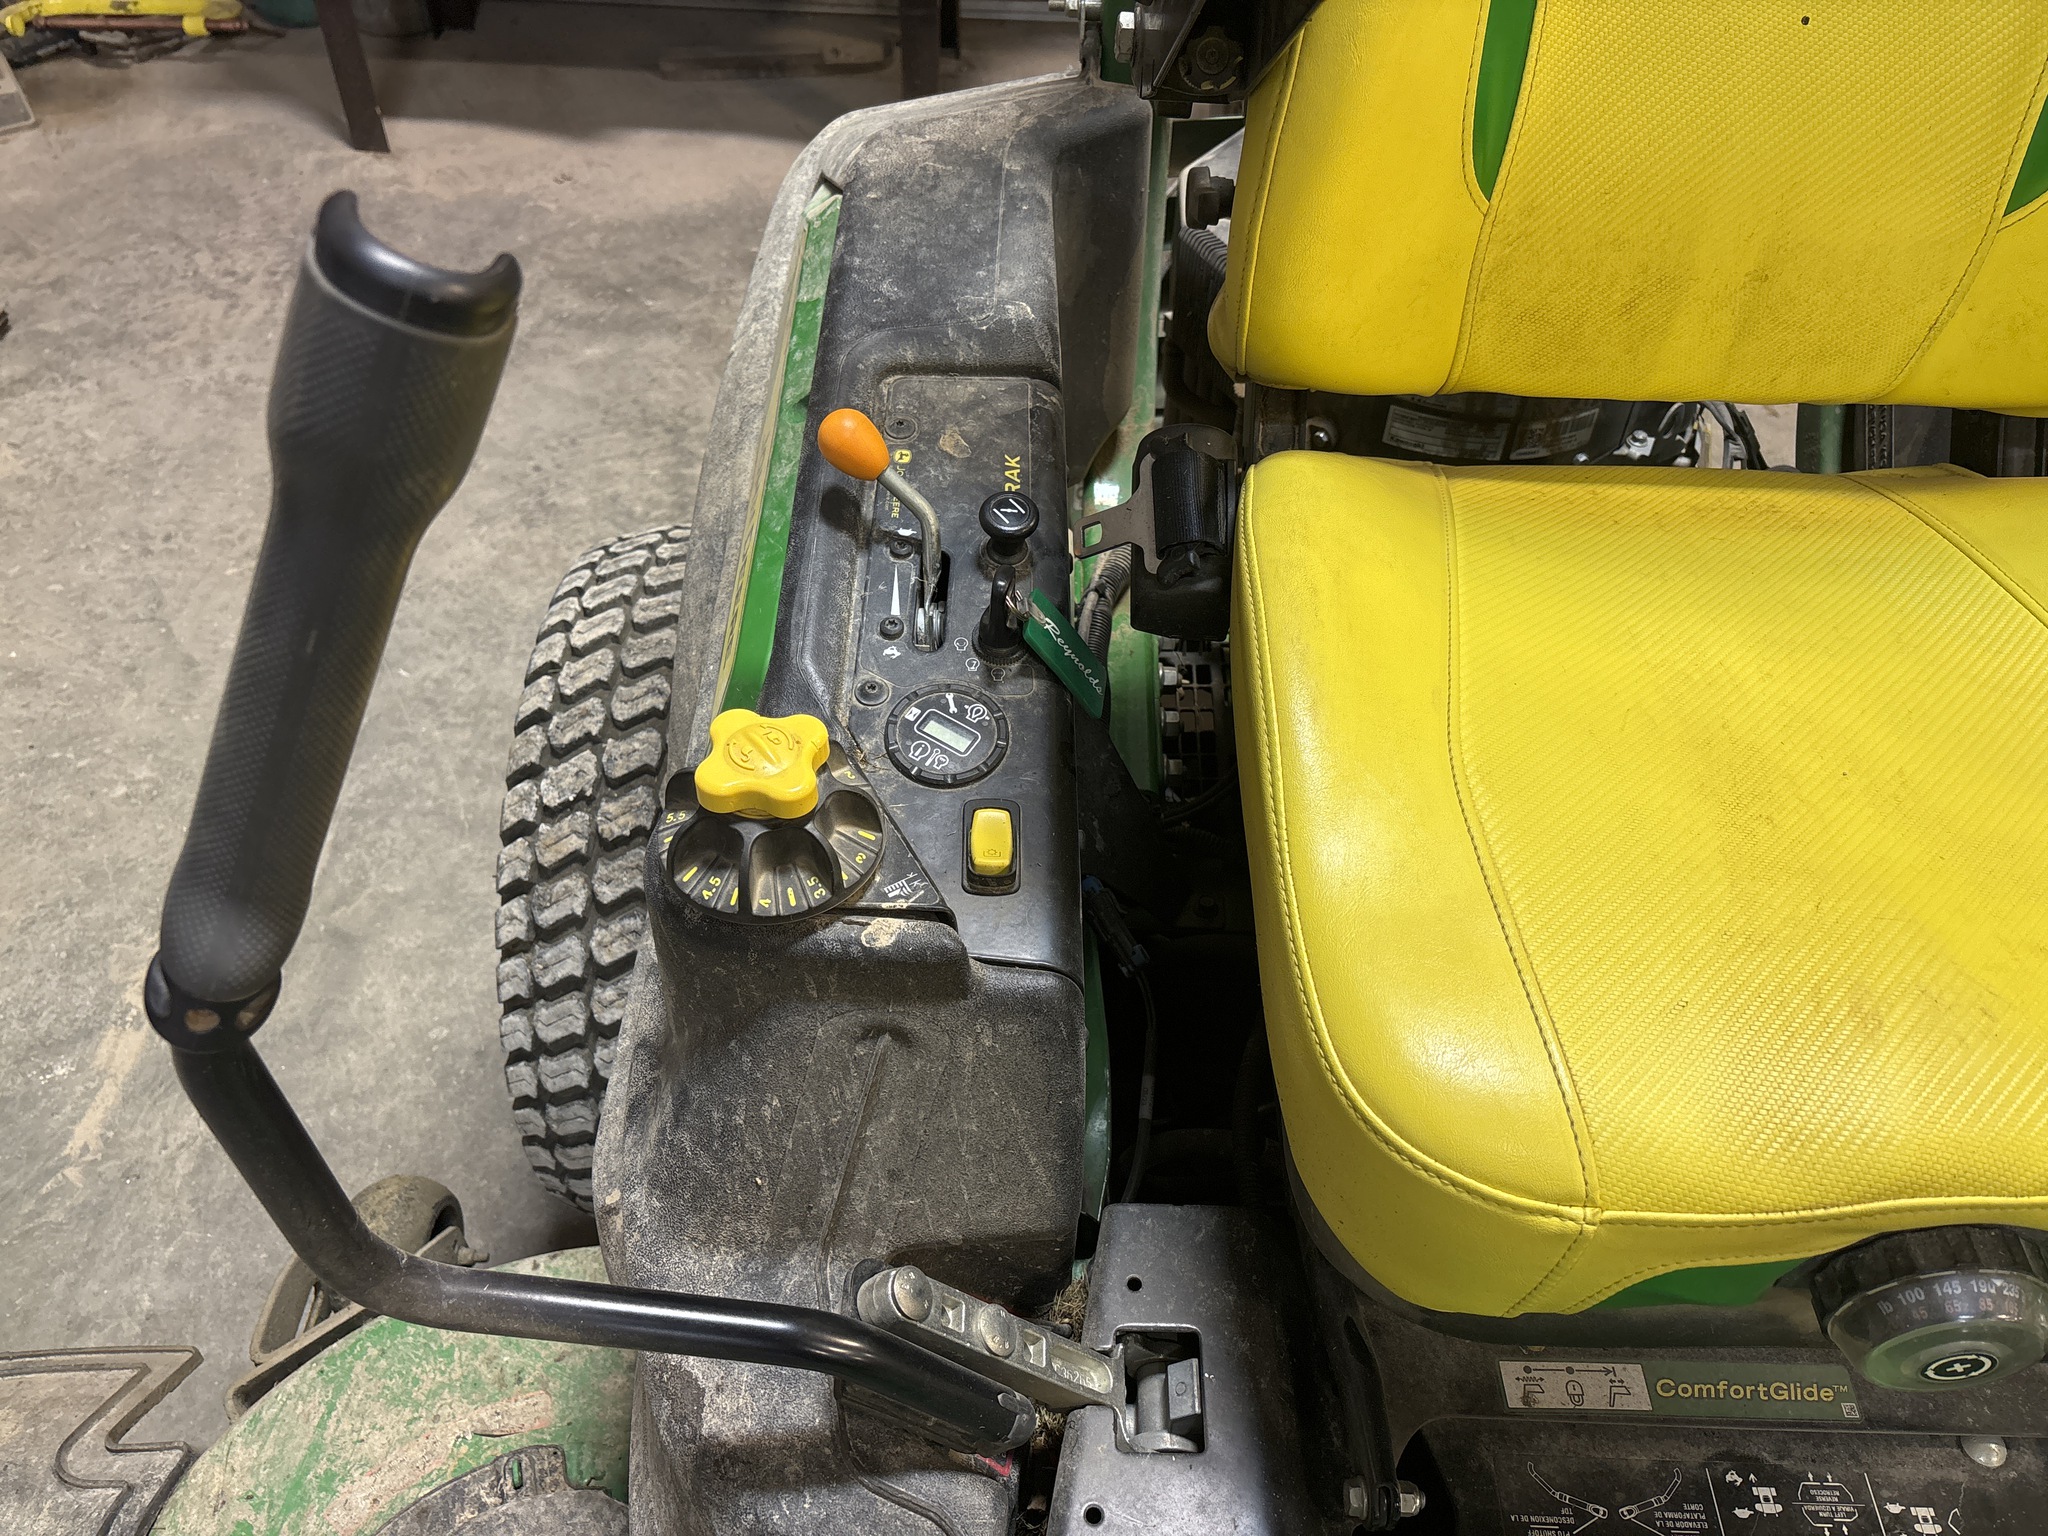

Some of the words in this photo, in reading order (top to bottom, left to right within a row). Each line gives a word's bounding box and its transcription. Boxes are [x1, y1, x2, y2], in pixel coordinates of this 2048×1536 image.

[1004, 453, 1021, 492] RAK
[1043, 617, 1104, 696] Reynolds
[843, 770, 856, 780] 2
[665, 810, 686, 824] 5.5
[855, 852, 867, 864] 3
[702, 875, 722, 900] 4.5
[806, 876, 827, 899] 3.5
[758, 898, 772, 908] 4
[1876, 1300, 1894, 1316] lb
[1896, 1287, 1925, 1306] 100
[1932, 1280, 1962, 1297] 145
[1970, 1279, 1996, 1295] 190
[2002, 1282, 2020, 1299] 235
[1561, 1507, 1573, 1515] TDF
[1683, 1503, 1704, 1511] CORTE
[1510, 1514, 1520, 1522] LA
[1663, 1511, 1706, 1520] PLATAFORMA
